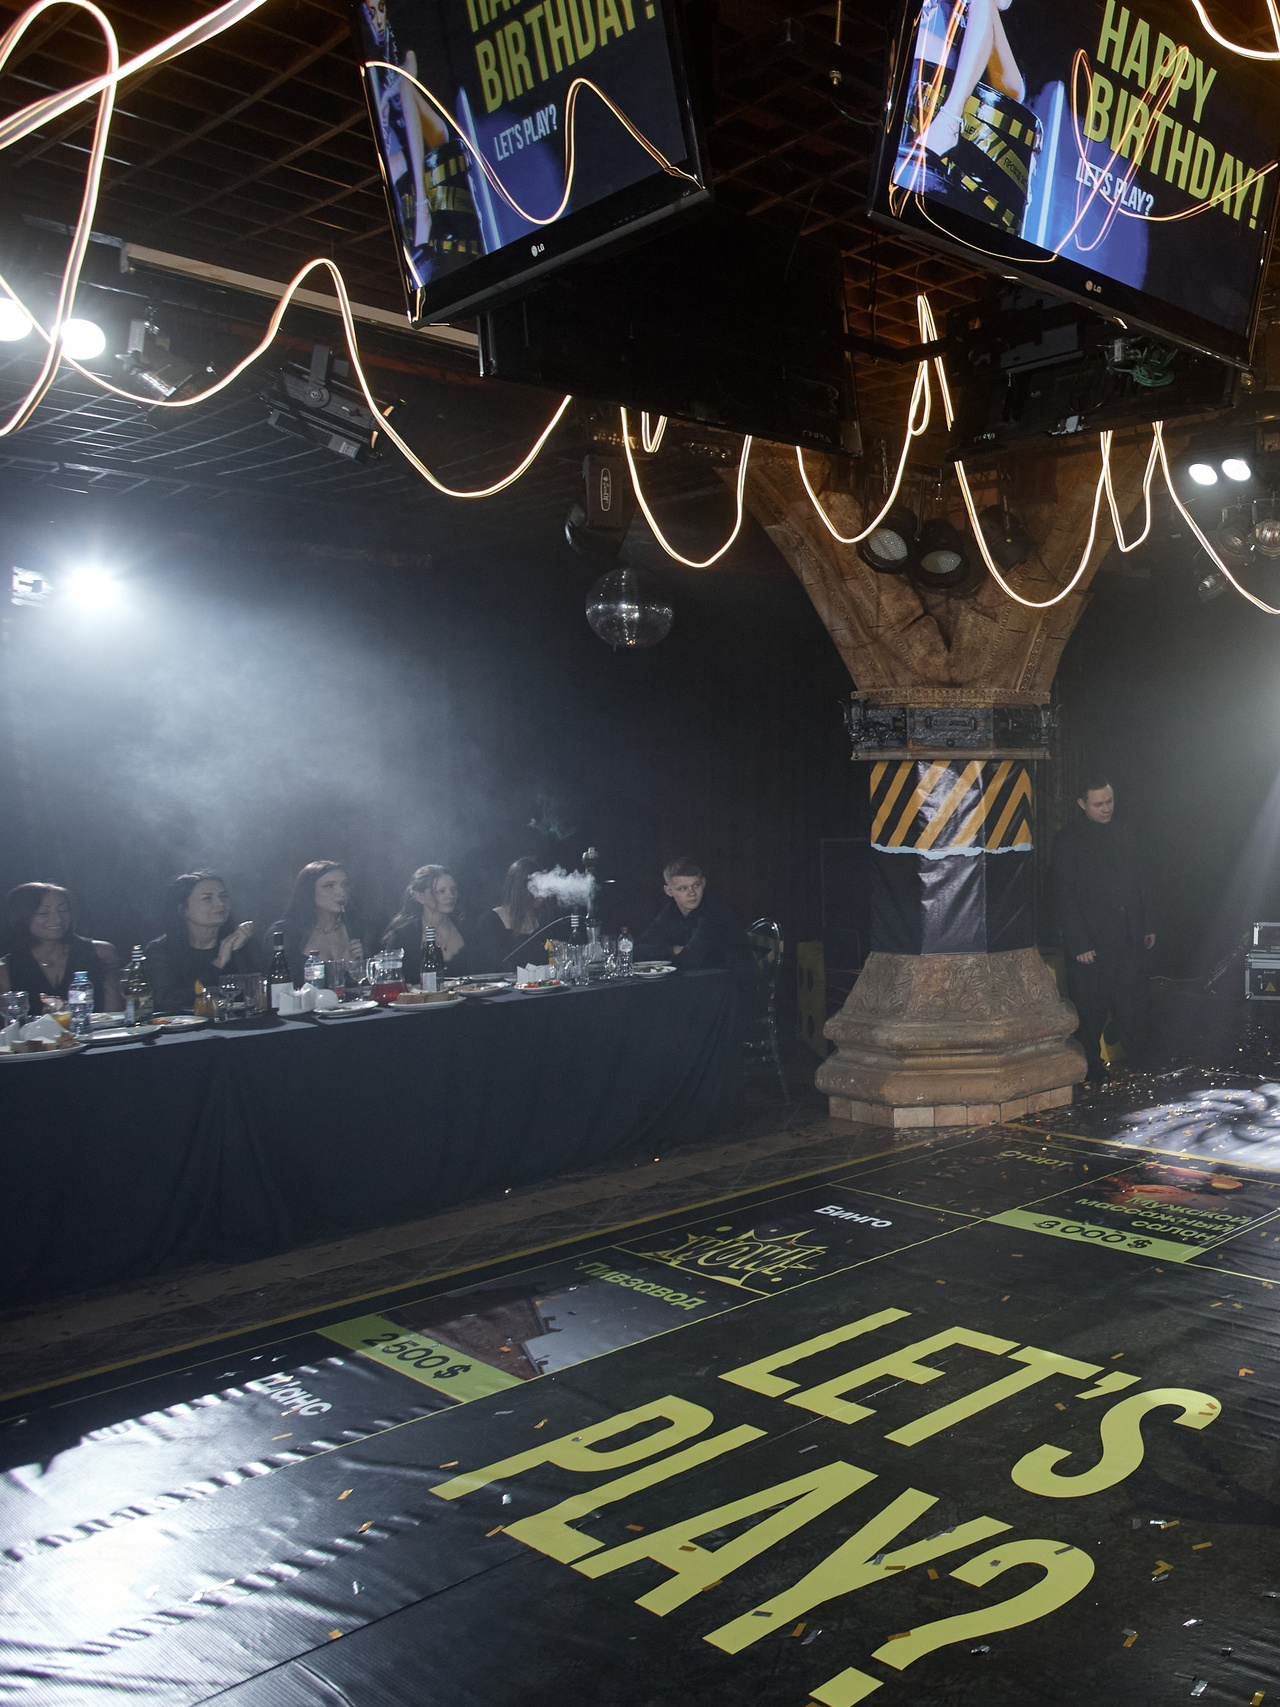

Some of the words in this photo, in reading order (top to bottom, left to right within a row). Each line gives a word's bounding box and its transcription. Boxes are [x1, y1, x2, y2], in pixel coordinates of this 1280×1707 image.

[475, 0, 656, 114] BIRTHDA
[1097, 0, 1217, 124] HAPPY
[493, 124, 524, 162] LET'S
[522, 103, 558, 146] PLAY?
[1083, 72, 1265, 230] BIRTHDAY!
[1113, 177, 1155, 217] PLAY?
[999, 1150, 1075, 1167] Старт
[813, 1204, 893, 1228] Бинго
[1075, 1198, 1236, 1233] массажный
[1125, 1196, 1253, 1225] Мужской
[1131, 1220, 1217, 1242] салон
[574, 1261, 708, 1311] Пивзавод
[718, 1307, 1223, 1498] LET'S
[429, 1394, 1096, 1706] PLAY?
